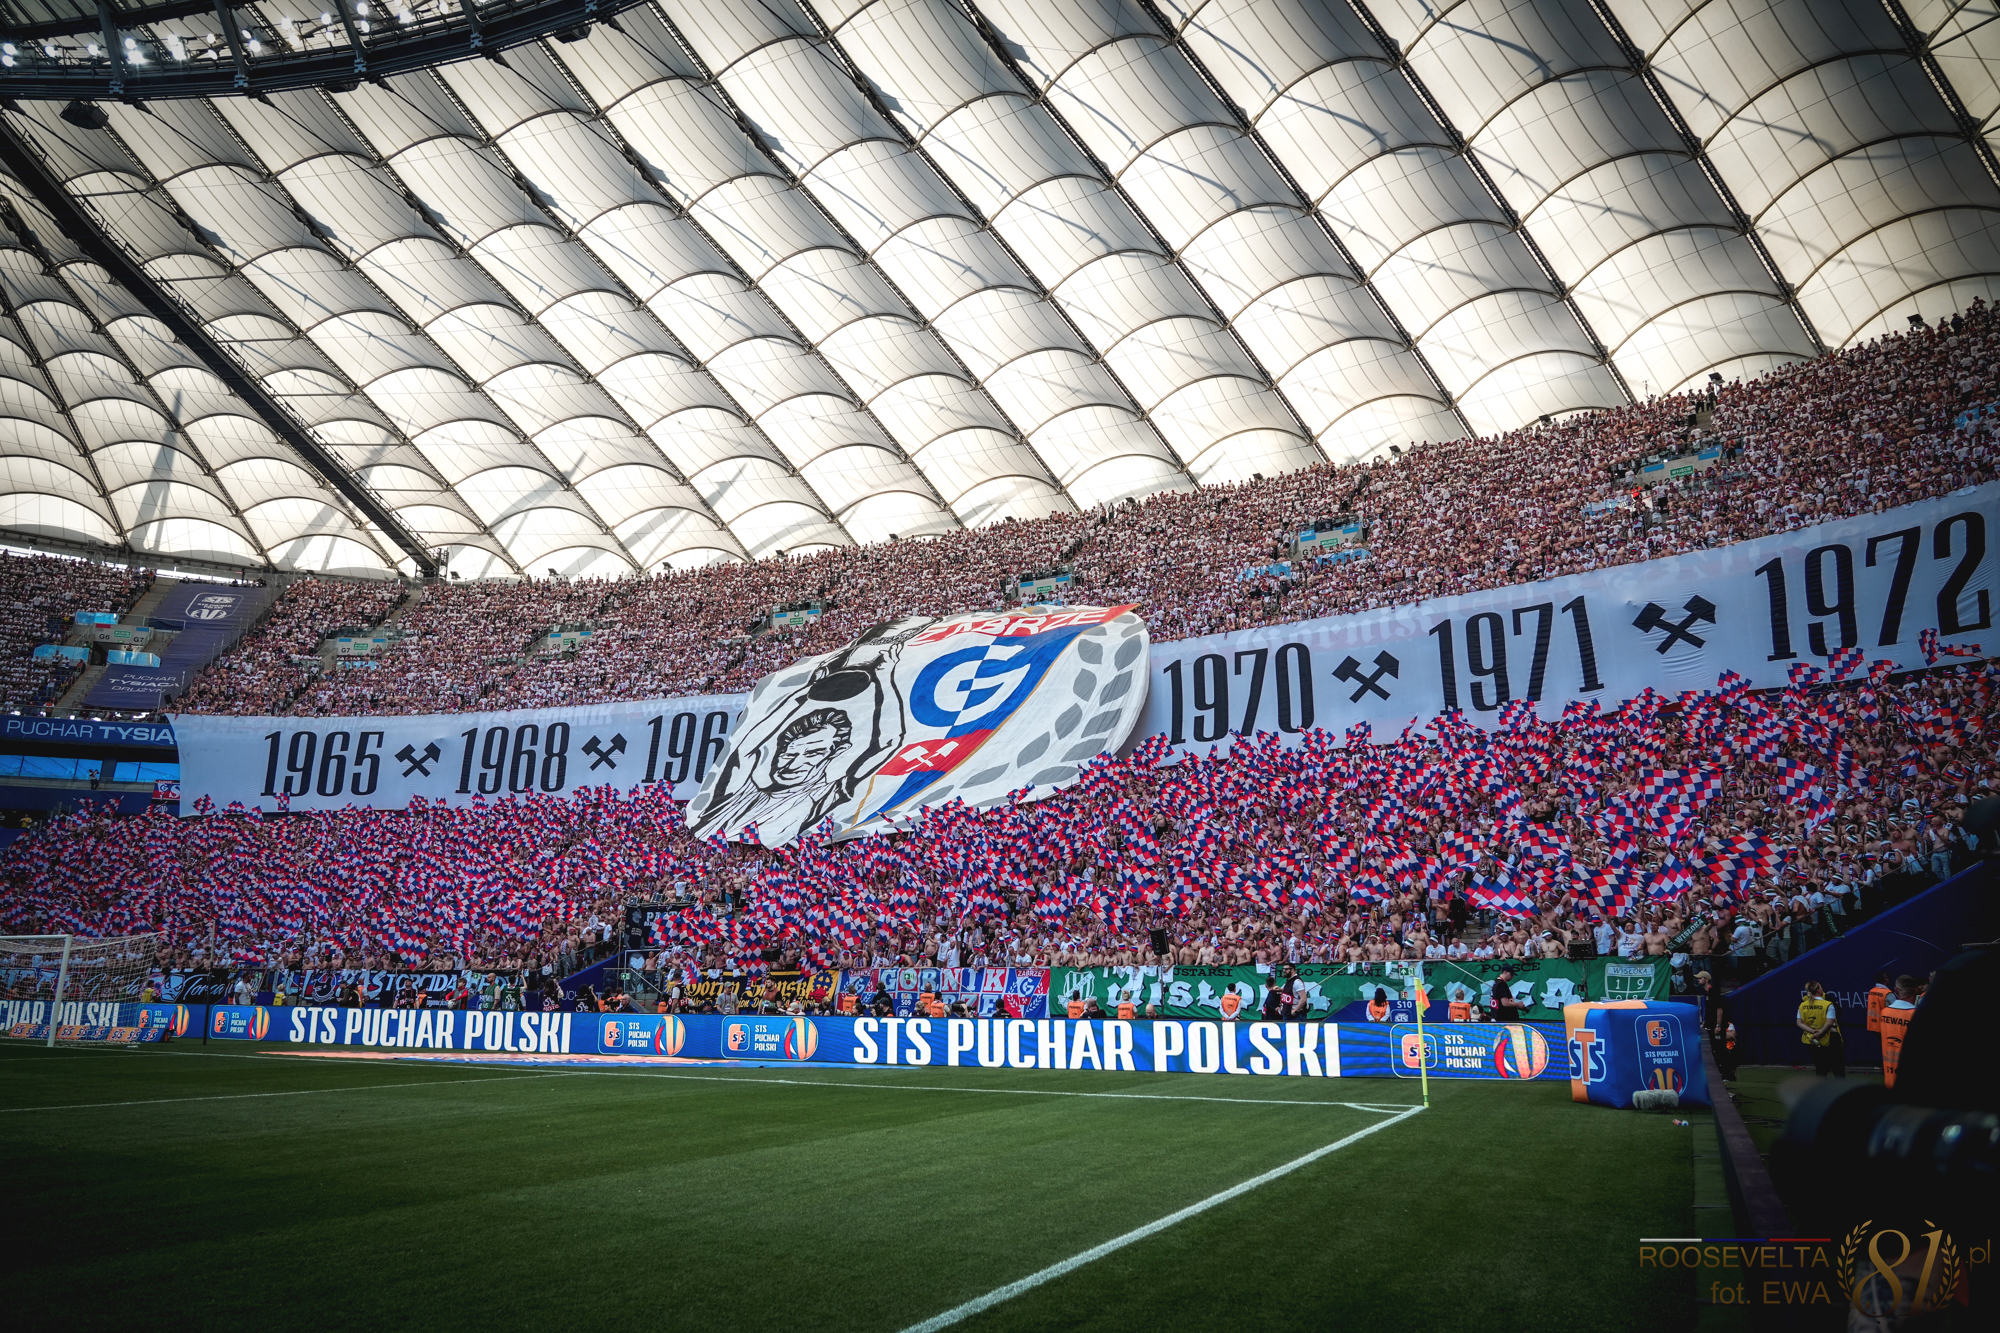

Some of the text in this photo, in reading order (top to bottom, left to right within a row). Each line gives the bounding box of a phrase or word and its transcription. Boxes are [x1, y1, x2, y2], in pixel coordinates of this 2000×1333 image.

[1755, 512, 1991, 661] 1972
[1429, 595, 1604, 715] 1971
[123, 673, 177, 681] PUCHAR
[1163, 643, 1315, 745] 1970
[6, 720, 93, 738] PUCHAR
[641, 711, 740, 784] 196
[260, 731, 384, 796] 1965
[455, 722, 570, 794] 1968
[1018, 969, 1043, 977] ZABRZE
[1637, 979, 1644, 990] 9
[1396, 1001, 1412, 1009] S10
[289, 1007, 572, 1053] STS PUCHAR POLSKI
[628, 1022, 640, 1030] STS
[754, 1025, 767, 1033] STS
[143, 1028, 159, 1042] STS
[628, 1031, 651, 1039] PUCHAR
[754, 1034, 780, 1042] PUCHAR
[1652, 1027, 1667, 1039] STS
[1444, 1035, 1464, 1044] STS
[754, 1043, 777, 1051] POLSKI
[853, 1017, 1341, 1077] STS PUCHAR POLSKI
[1445, 1047, 1486, 1056] PUCHAR
[1568, 1028, 1607, 1085] STS
[1446, 1059, 1482, 1068] POLSKI
